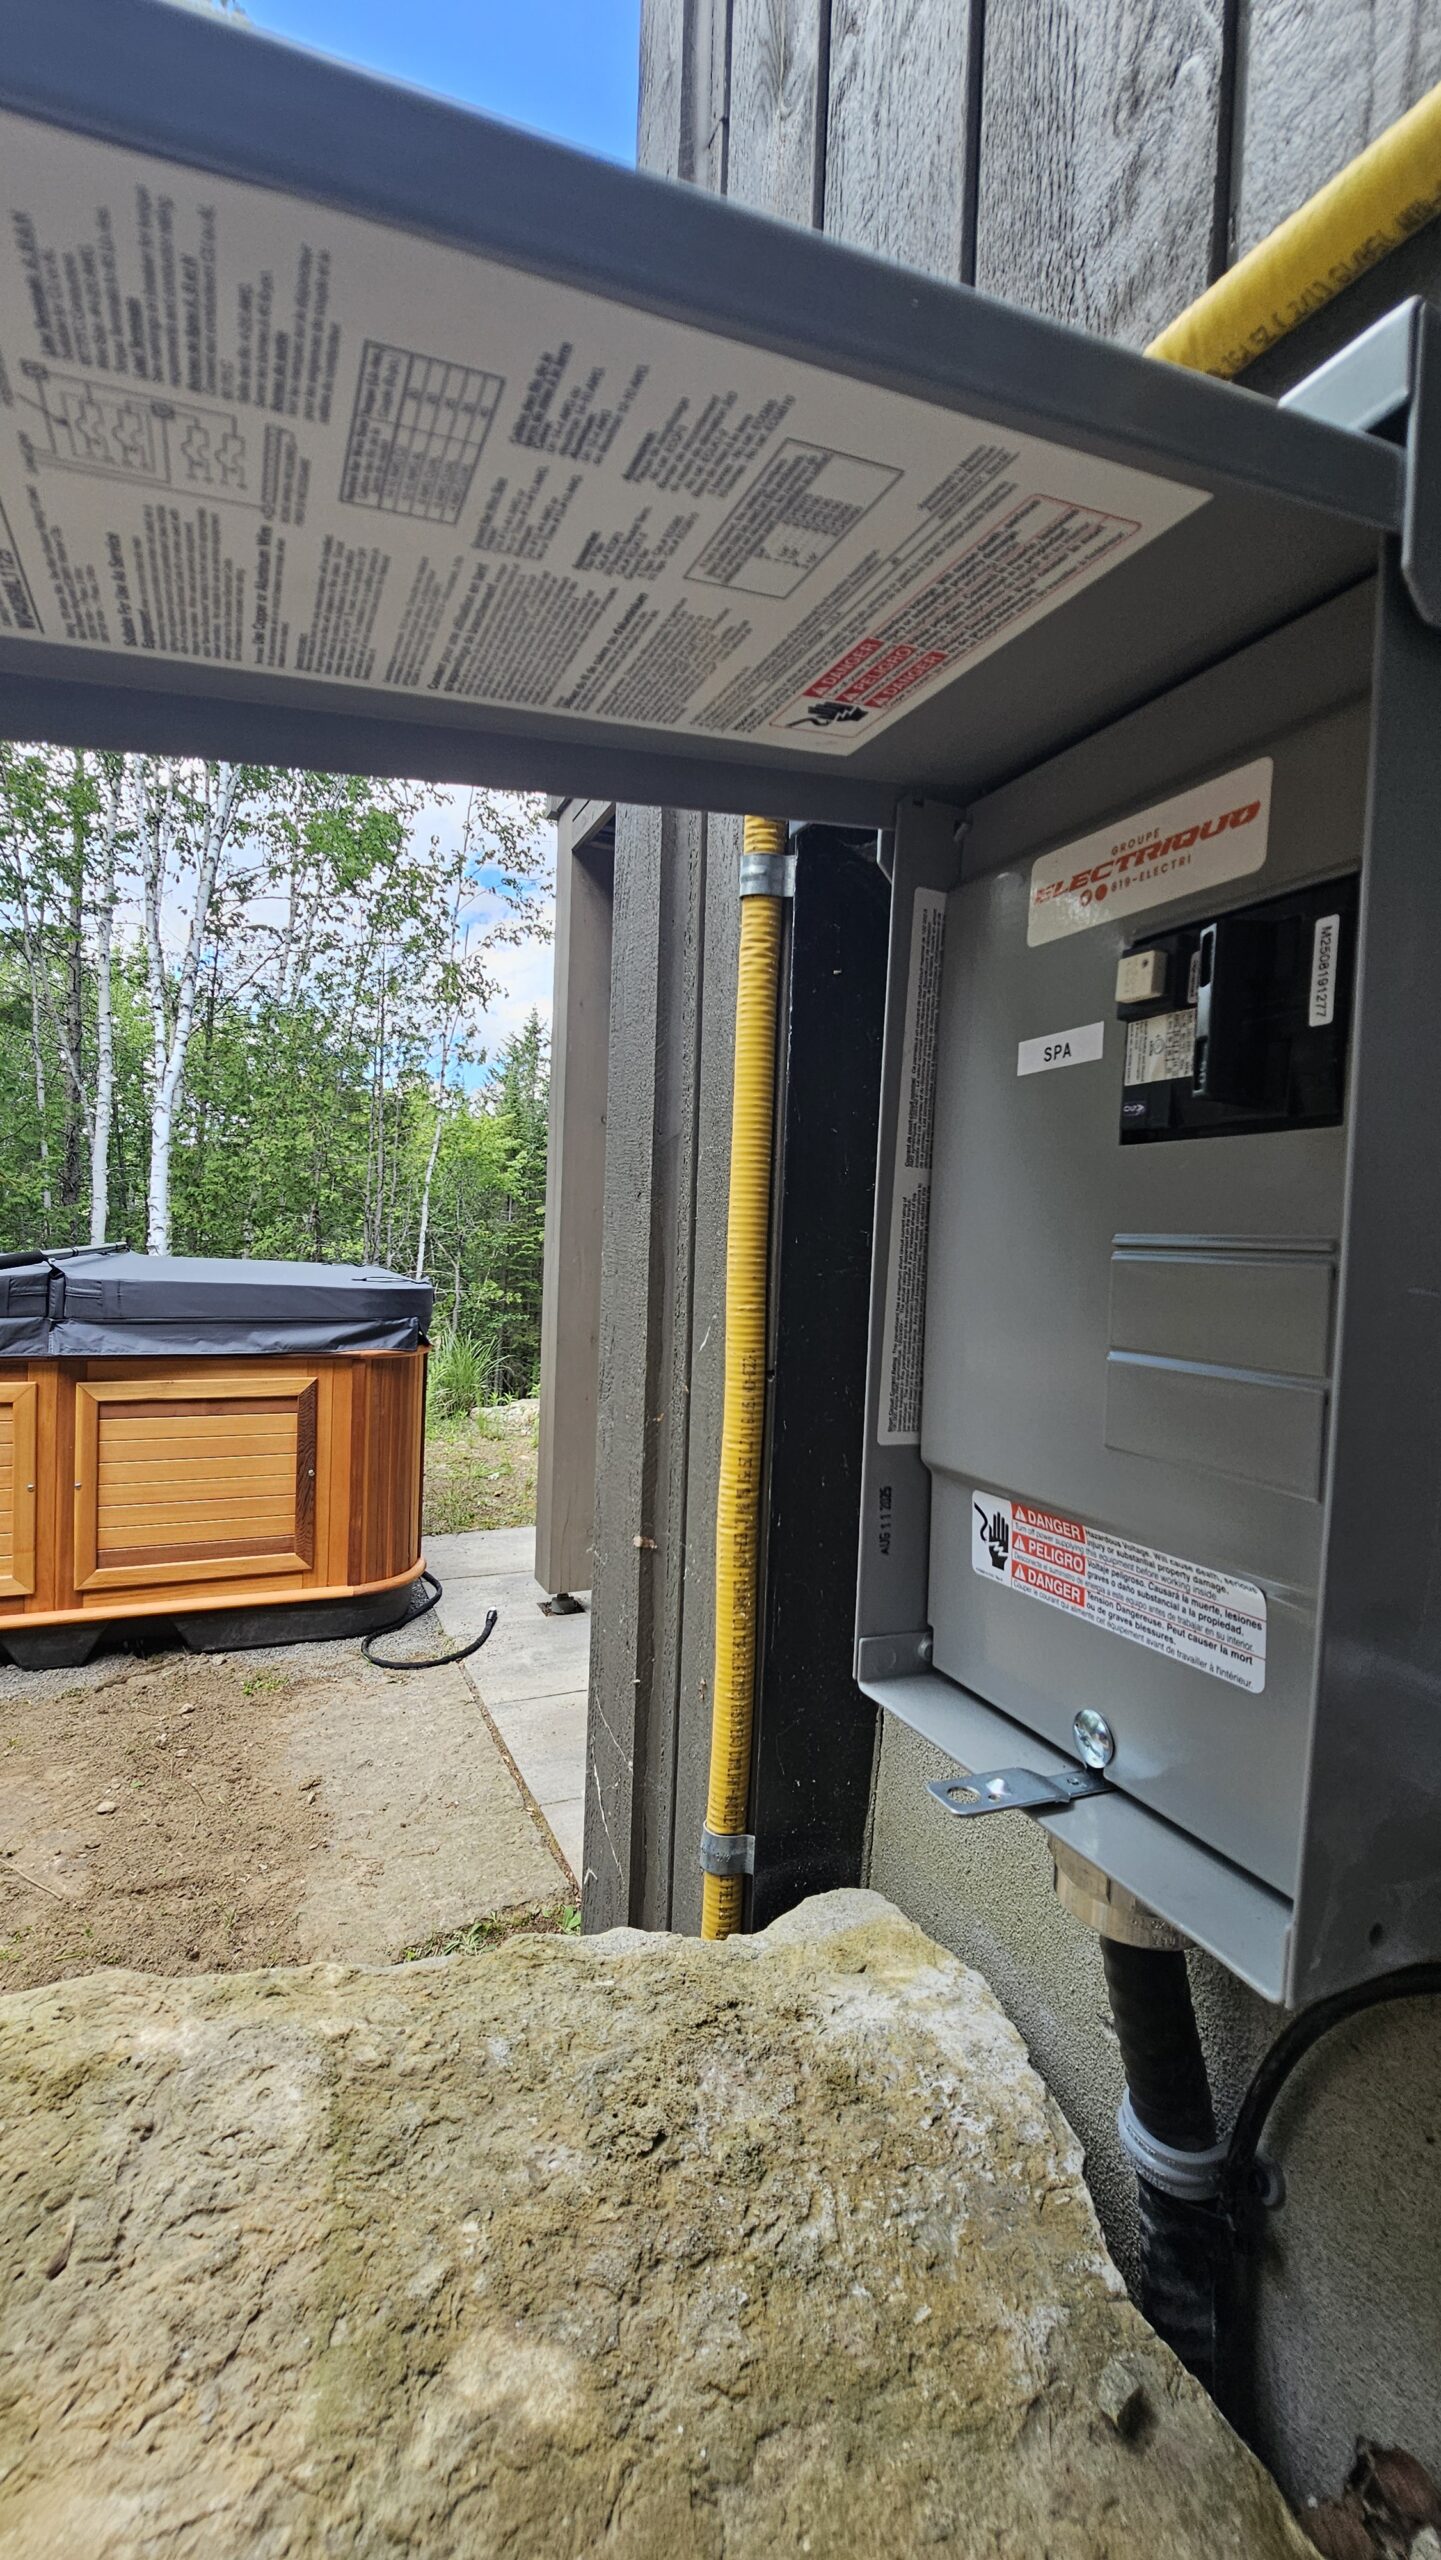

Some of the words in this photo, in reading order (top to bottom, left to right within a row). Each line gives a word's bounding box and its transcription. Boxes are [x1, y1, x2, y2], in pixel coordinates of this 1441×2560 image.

[822, 642, 880, 688] DANGER
[854, 647, 913, 695] PELIGRO
[884, 655, 940, 705] DANGER
[1111, 827, 1160, 856] GROUPE
[1043, 1042, 1072, 1063] SPA
[879, 1532, 892, 1556] AUG
[1027, 1509, 1080, 1540] DANGER
[1014, 1521, 1026, 1532] Turn
[1035, 1530, 1052, 1544] power
[1055, 1536, 1084, 1556] supplying
[1086, 1547, 1096, 1558] this
[1099, 1552, 1135, 1574] equipment
[1136, 1564, 1158, 1580] before
[1161, 1573, 1190, 1594] working
[1028, 1538, 1083, 1573] PELIGRO
[1086, 1538, 1104, 1553] injury
[1106, 1546, 1113, 1554] or
[1114, 1547, 1154, 1568] substantial
[1157, 1562, 1190, 1582] property
[1192, 1574, 1229, 1596] damage.
[1027, 1567, 1080, 1603] DANGER
[1087, 1558, 1109, 1576] Voltaje
[1111, 1567, 1145, 1590] peligroso.
[1148, 1580, 1179, 1600] Causará
[1181, 1592, 1188, 1604] la
[1191, 1596, 1221, 1617] muerte,
[1224, 1608, 1262, 1631] lesiones
[1087, 1570, 1109, 1586] graves
[1111, 1579, 1115, 1587] o
[1117, 1580, 1134, 1594] daño
[1136, 1587, 1179, 1611] substancial
[1182, 1606, 1186, 1614] a
[1188, 1607, 1196, 1618] la
[1198, 1610, 1244, 1638] propiedad.
[1086, 1602, 1094, 1611] ou
[1097, 1605, 1105, 1615] de
[1108, 1611, 1132, 1628] graves
[1134, 1621, 1175, 1645] blessures.
[1087, 1590, 1113, 1608] Tension
[1116, 1602, 1164, 1631] Dangereuse.
[1166, 1622, 1185, 1638] Peut
[1187, 1631, 1216, 1651] causer
[1220, 1644, 1227, 1655] la
[1230, 1648, 1252, 1666] mort
